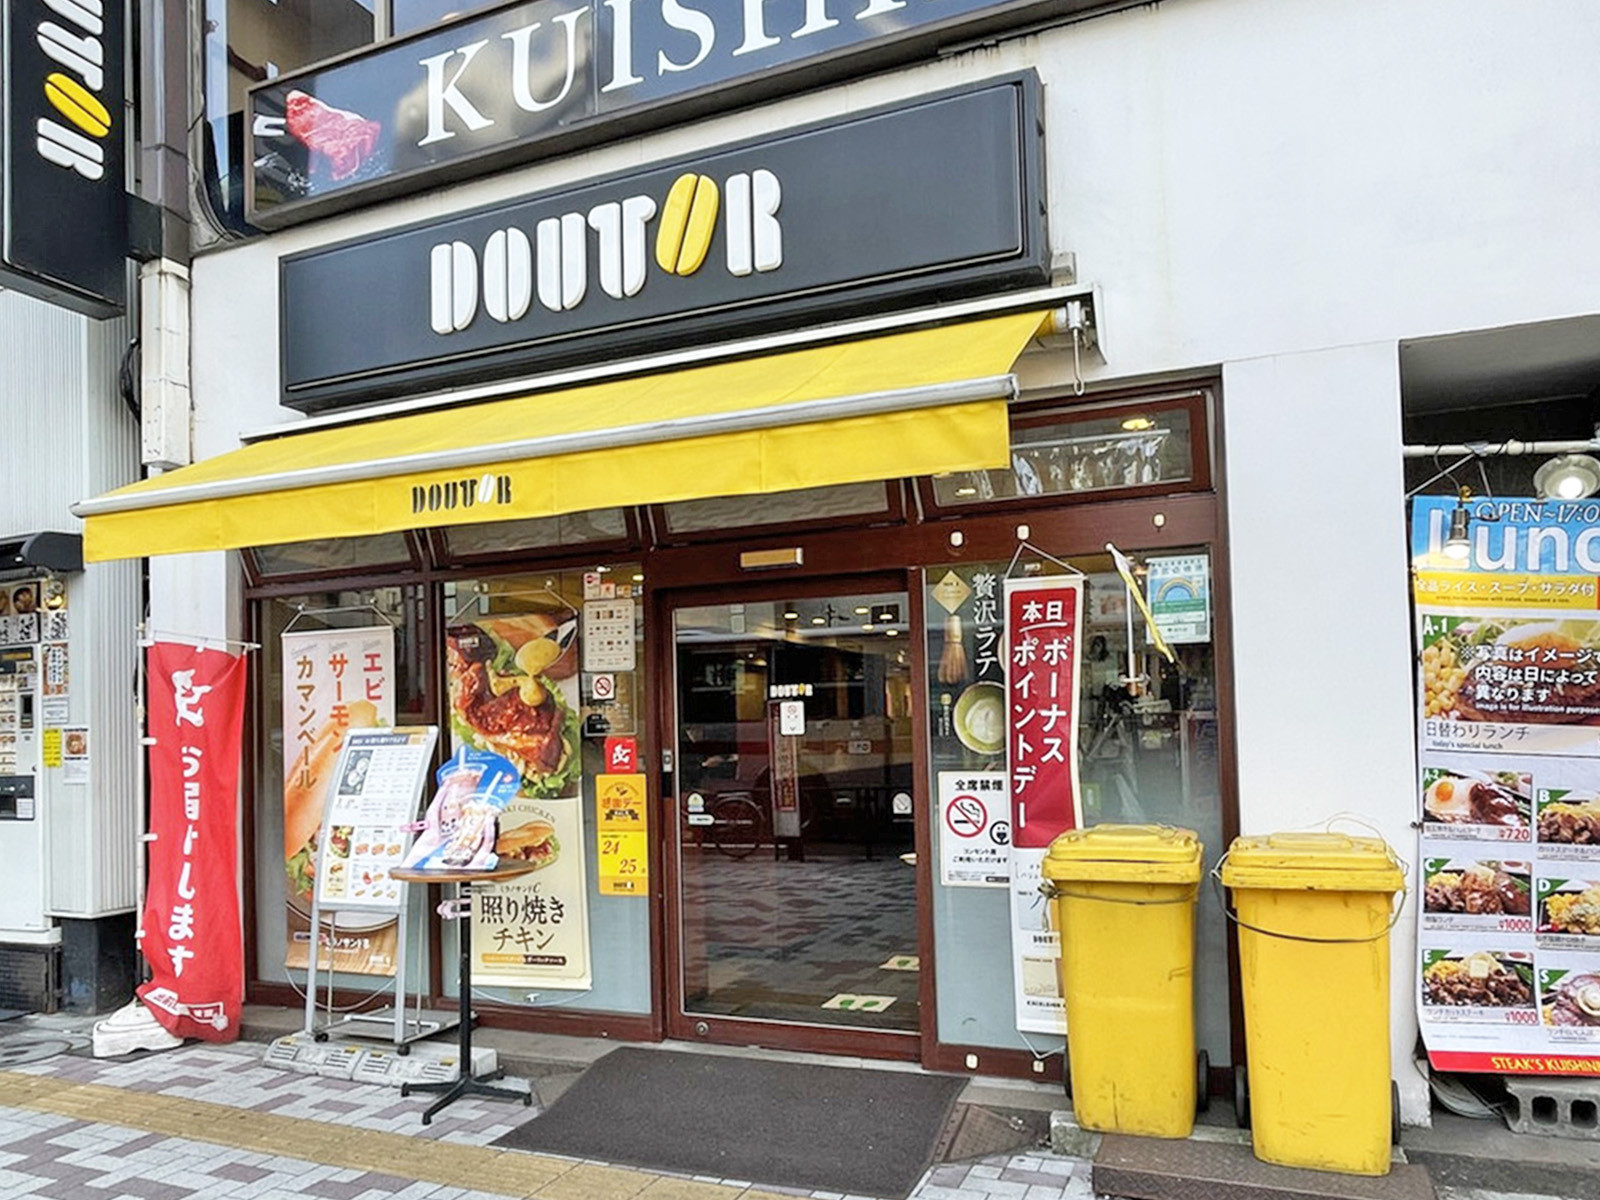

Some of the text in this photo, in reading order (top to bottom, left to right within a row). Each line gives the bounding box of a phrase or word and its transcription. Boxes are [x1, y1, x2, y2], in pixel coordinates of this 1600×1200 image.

[418, 0, 907, 146] KUIS
[430, 168, 782, 334] DOUTOR
[412, 473, 511, 514] DOUTOR
[1022, 601, 1063, 622] 本日
[972, 573, 997, 677] 贅沢ラテ
[363, 653, 385, 700] エビ
[1475, 666, 1597, 684] 内容は日によって
[1040, 636, 1071, 763] ボーナス
[1475, 684, 1550, 701] 異なります
[297, 655, 317, 789] カマンベール
[1426, 722, 1530, 740] 日替わりランチ
[1013, 638, 1037, 828] ポイントデー
[955, 780, 1003, 791] 全席禁煙
[1539, 790, 1549, 802] B
[602, 840, 619, 854] 24
[619, 859, 637, 873] 25
[1425, 859, 1436, 872] C
[1539, 880, 1550, 892] D
[480, 895, 565, 925] 照り焼き
[493, 926, 555, 952] チキン
[1424, 951, 1432, 963] E
[1540, 970, 1549, 982] S
[1491, 1057, 1544, 1070] STEAK'S
